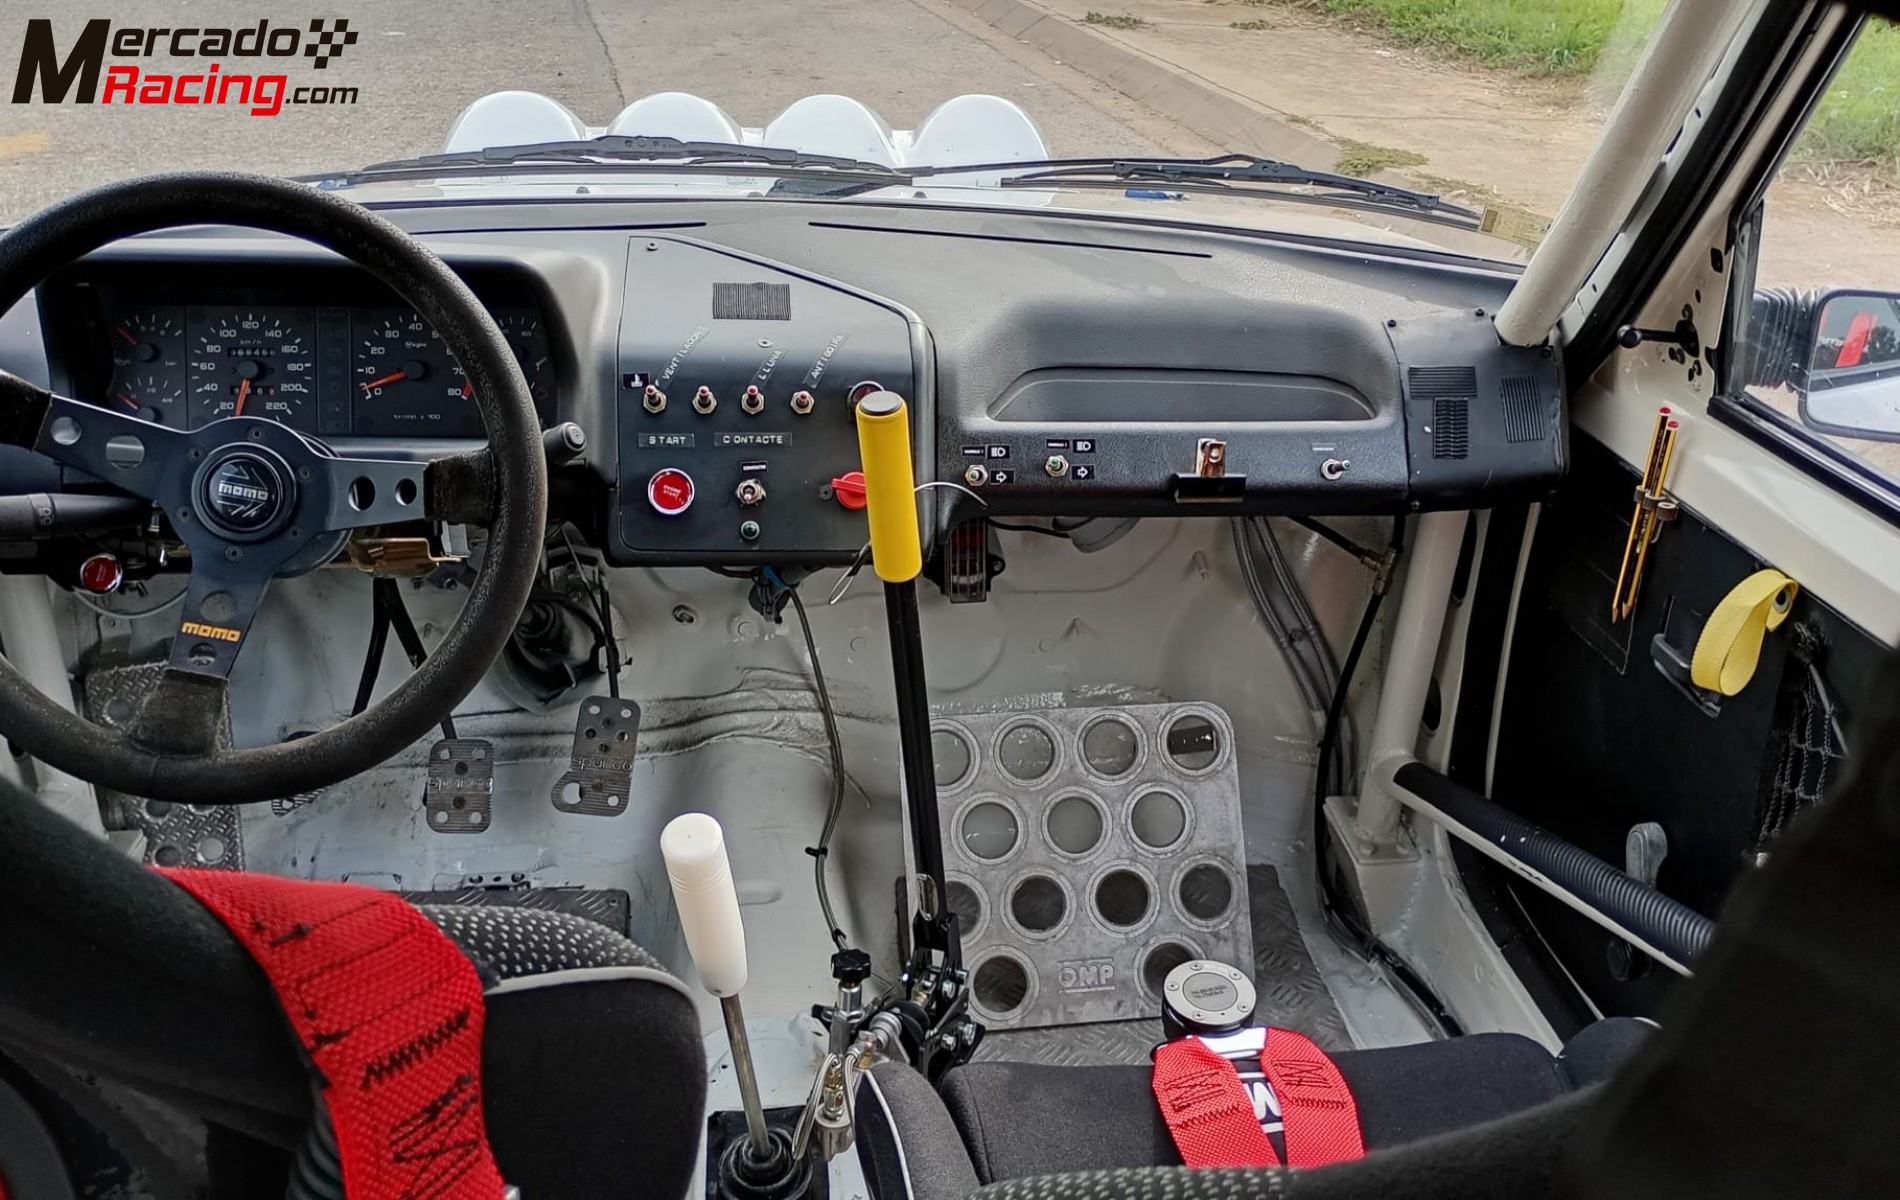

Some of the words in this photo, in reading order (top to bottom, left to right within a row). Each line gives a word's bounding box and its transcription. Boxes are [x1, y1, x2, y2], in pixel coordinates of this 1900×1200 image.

[242, 320, 259, 329] 120
[408, 323, 423, 331] 40
[219, 329, 237, 338] 100
[265, 330, 282, 338] 140
[206, 345, 222, 353] 80
[281, 345, 299, 353] 160
[370, 347, 385, 355] 20
[200, 362, 216, 371] 60
[287, 363, 304, 371] 180
[365, 366, 375, 375] 10
[204, 383, 218, 391] 40
[280, 383, 302, 392] 200
[374, 388, 382, 396] 0
[447, 388, 462, 396] 80
[219, 402, 235, 410] 20
[265, 402, 288, 410] 220
[649, 436, 687, 445] START
[722, 435, 783, 444] CONTACTE
[1058, 964, 1114, 988] OMP
